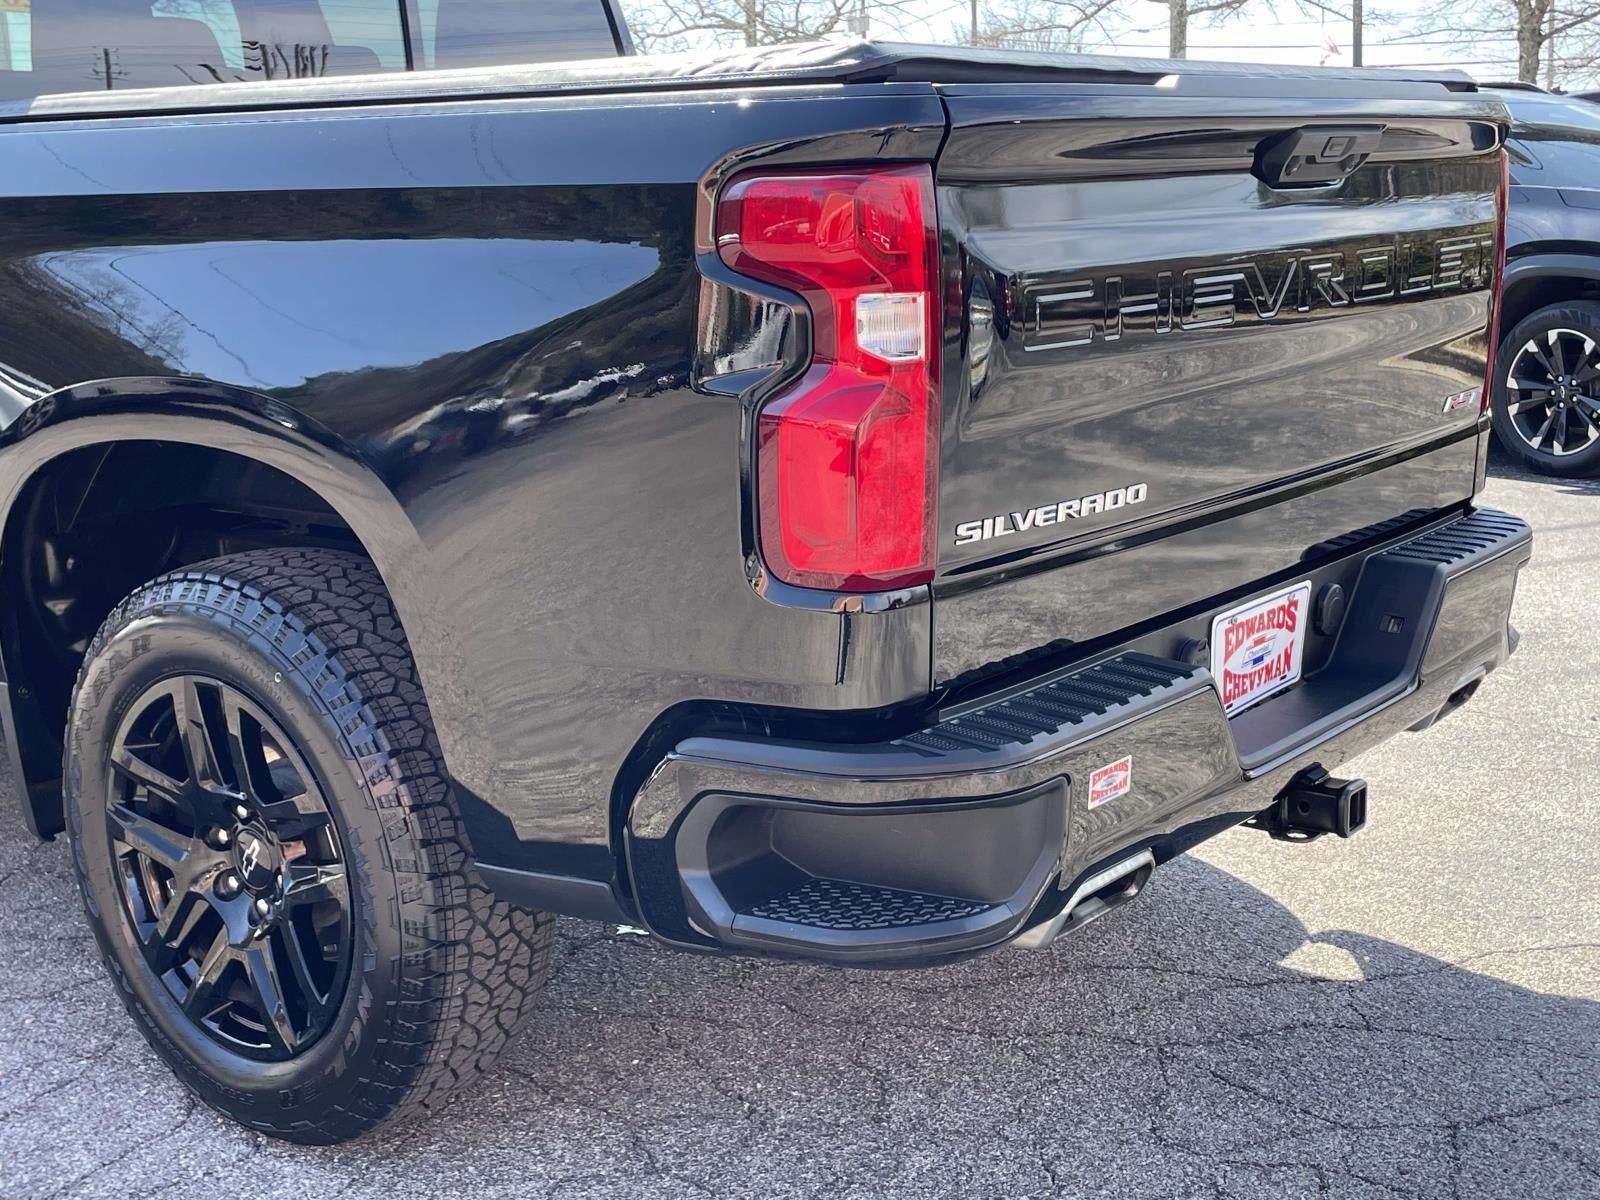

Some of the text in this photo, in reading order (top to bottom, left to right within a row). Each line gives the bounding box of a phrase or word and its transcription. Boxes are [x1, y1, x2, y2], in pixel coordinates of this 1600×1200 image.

[1023, 235, 1493, 352] CHEVROLET
[954, 482, 1149, 546] SILVERADO
[1223, 600, 1299, 665] EDWARDS
[1223, 639, 1294, 704] CHEVYMAN
